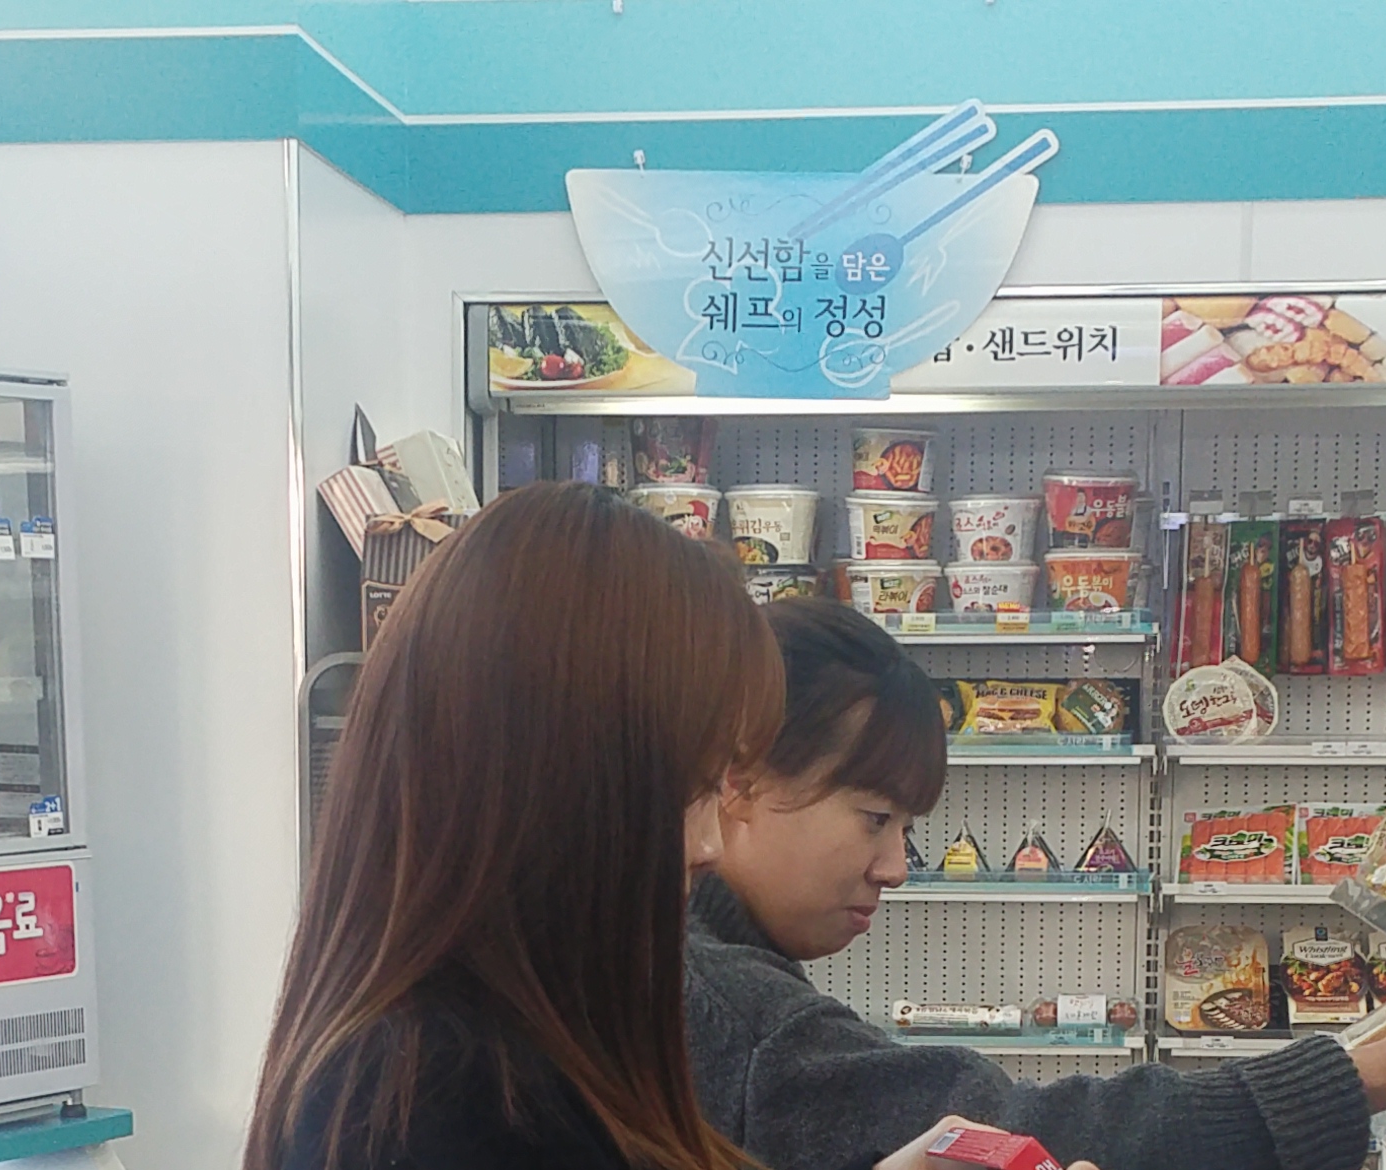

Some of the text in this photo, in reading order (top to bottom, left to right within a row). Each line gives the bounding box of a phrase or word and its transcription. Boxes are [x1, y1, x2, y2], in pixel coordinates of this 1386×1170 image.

[701, 237, 891, 283] 신선함을 담은
[701, 292, 886, 338] 쉐프의 정성
[1009, 688, 1048, 699] CHEESE
[45, 797, 62, 812] 2+1
